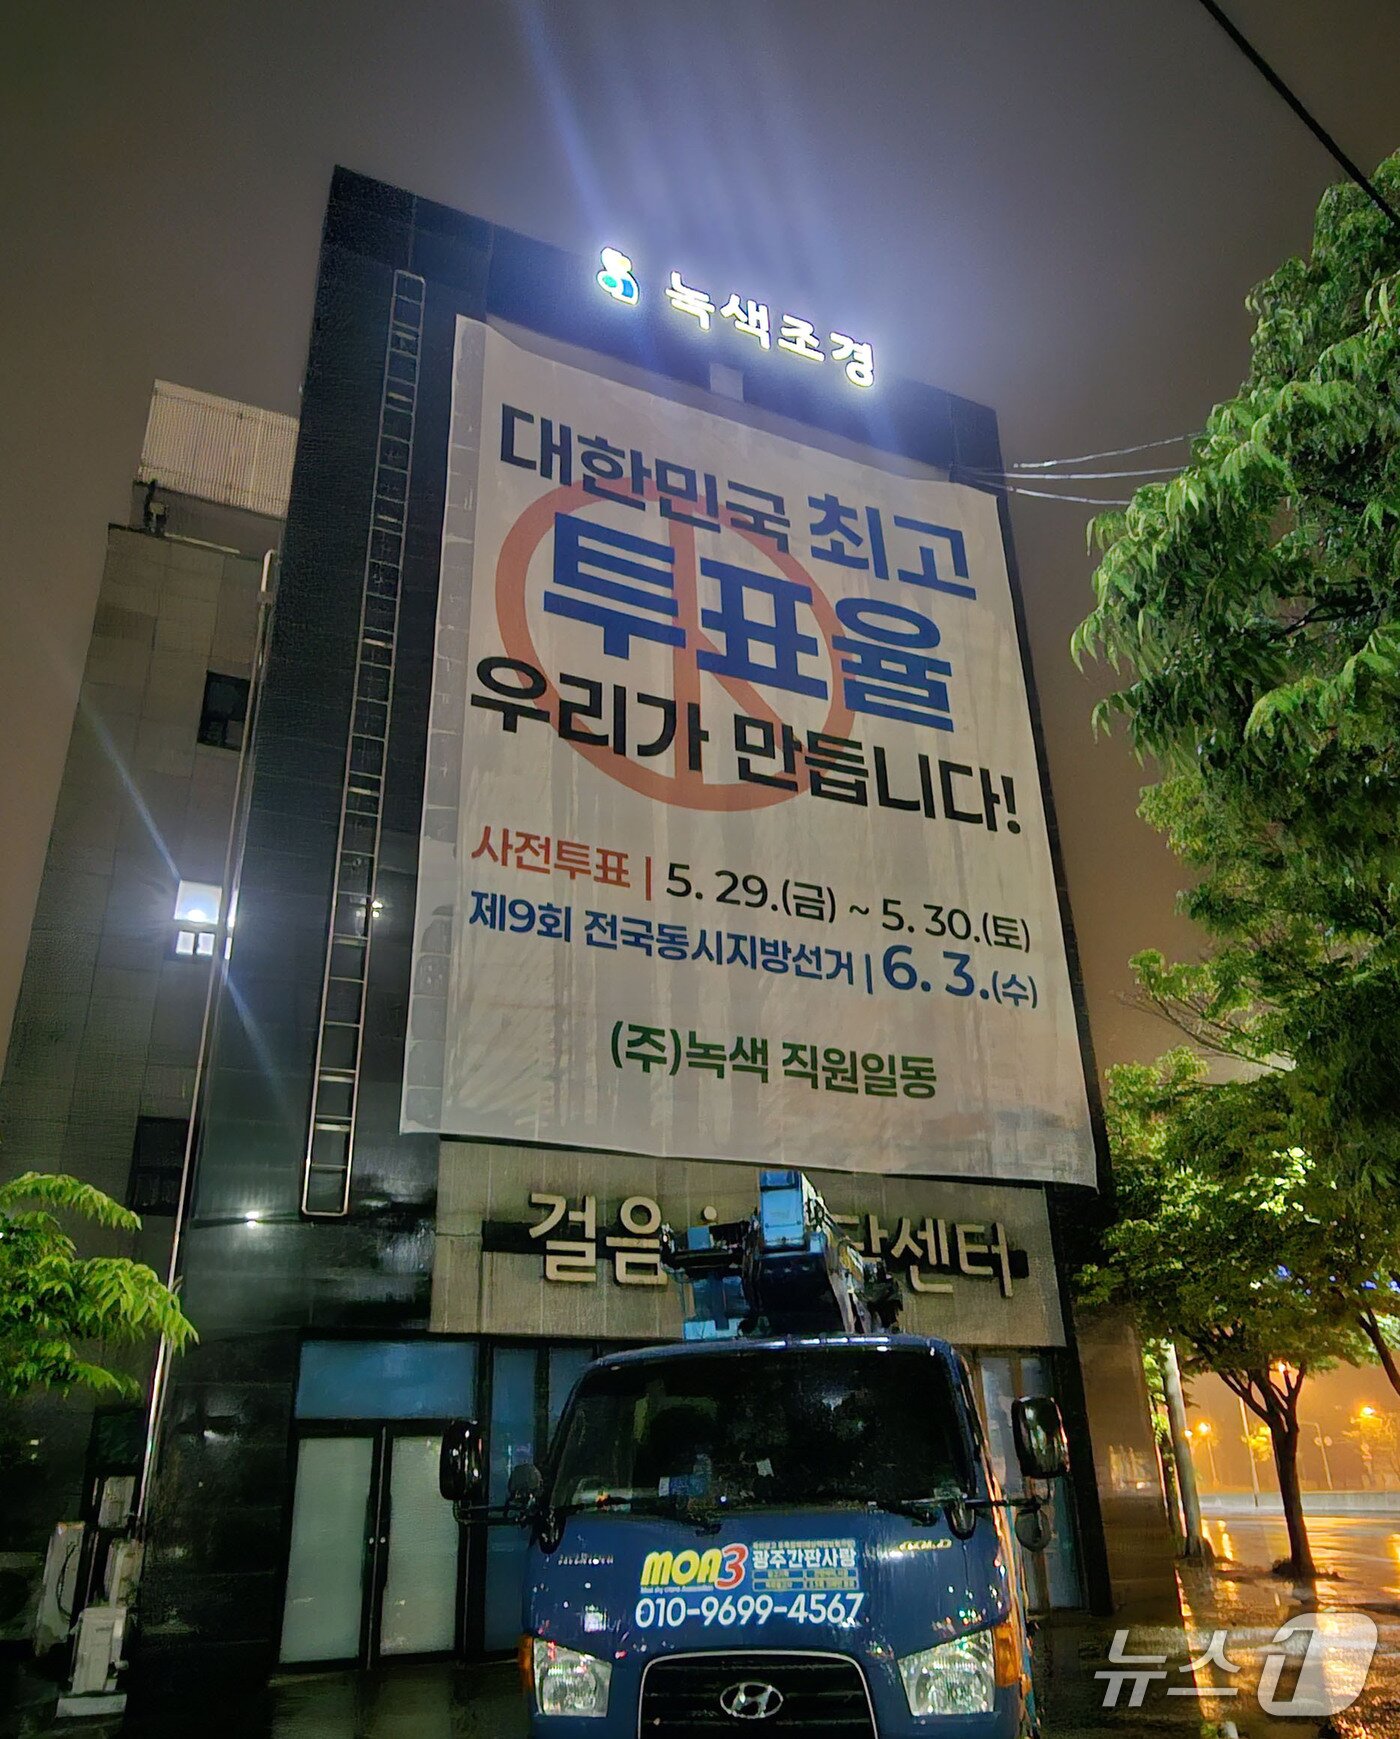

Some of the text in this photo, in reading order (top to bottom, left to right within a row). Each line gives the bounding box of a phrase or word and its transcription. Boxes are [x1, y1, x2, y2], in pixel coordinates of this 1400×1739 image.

[665, 271, 875, 388] 녹색조경
[501, 403, 977, 600] 대한민국 최고
[543, 512, 954, 733] 투표율
[470, 656, 1022, 834] 우리가 만듭니다!
[470, 826, 631, 888] 사전투표
[469, 890, 571, 942] 제9회
[584, 910, 854, 985] 전국동시지방선거
[611, 1021, 937, 1099] (주)녹색 직원일동
[529, 1194, 669, 1286] 걸음
[635, 1593, 864, 1628] 010-9699-4567
